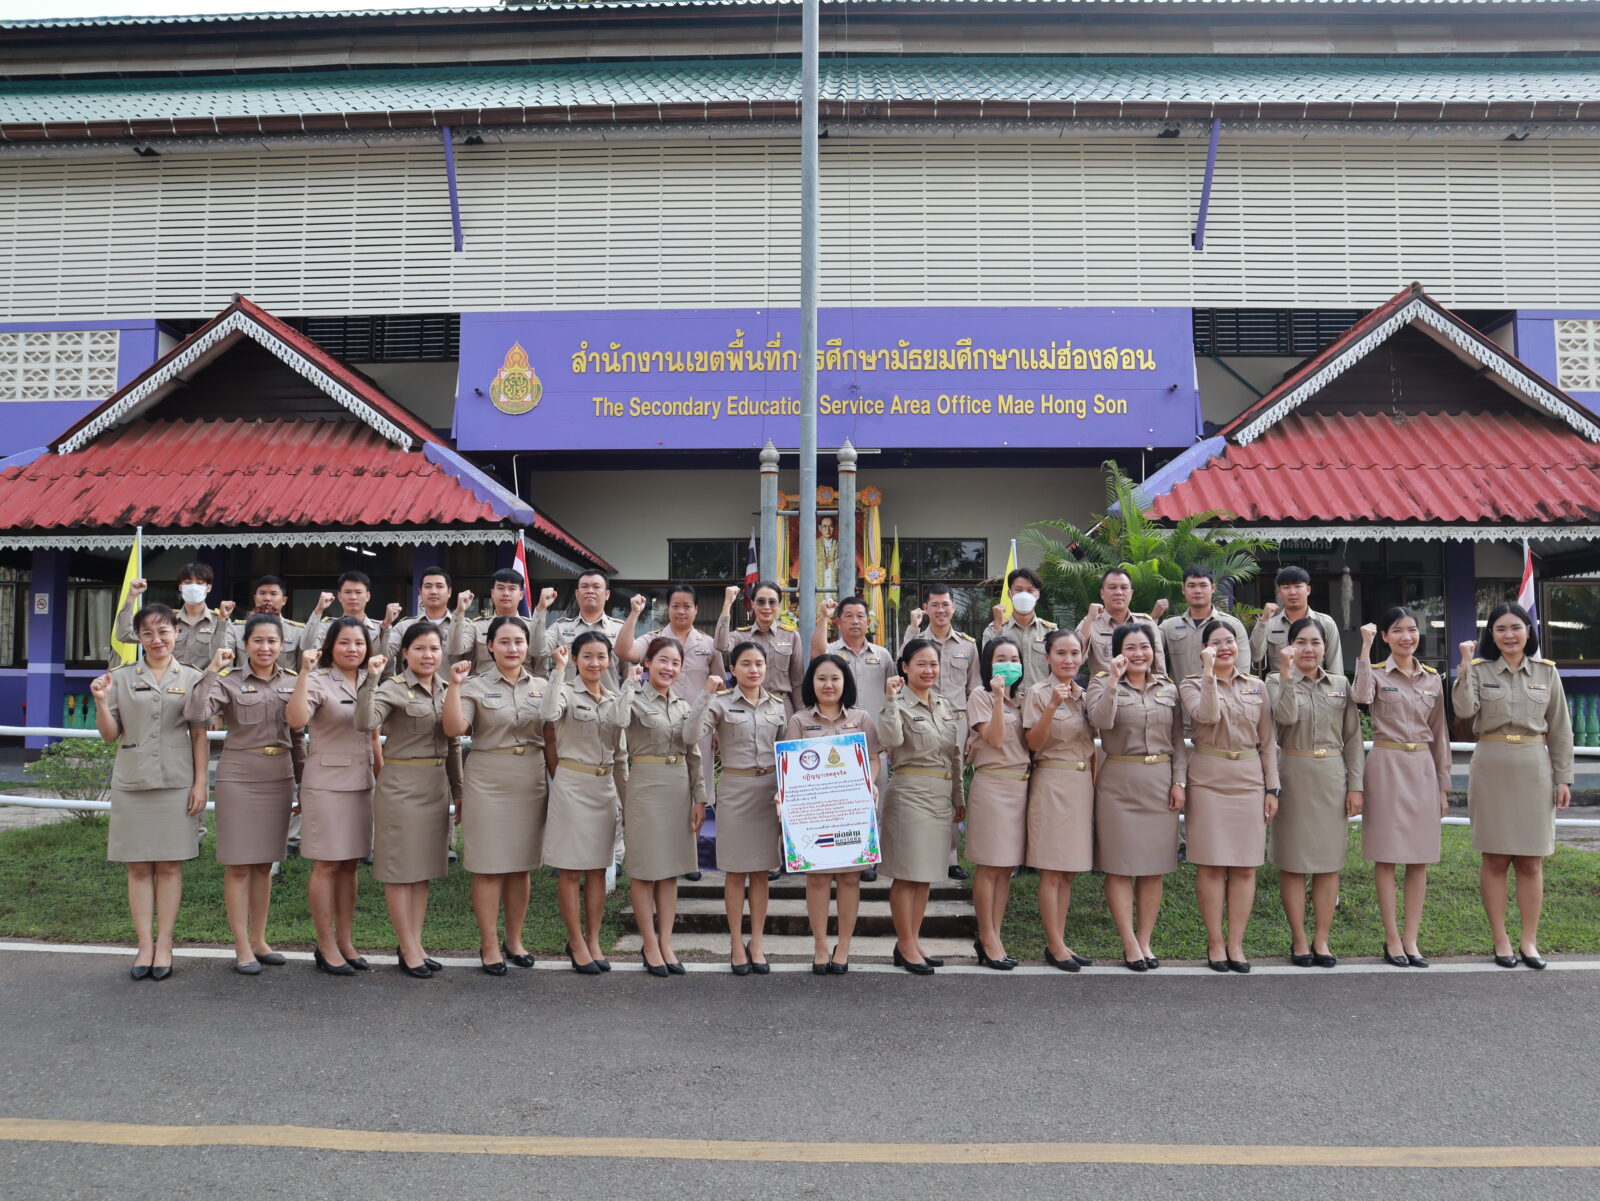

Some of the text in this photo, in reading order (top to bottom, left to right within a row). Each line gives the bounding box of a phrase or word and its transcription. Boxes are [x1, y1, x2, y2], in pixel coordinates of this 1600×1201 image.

[571, 328, 1157, 374] สำนักงานเขตพื้นที่กรศึกษามัธยมศึกษาแม่ฮ่องสอน
[592, 393, 1128, 420] The Secondary Educatio Service Area Office Mae Hong Son
